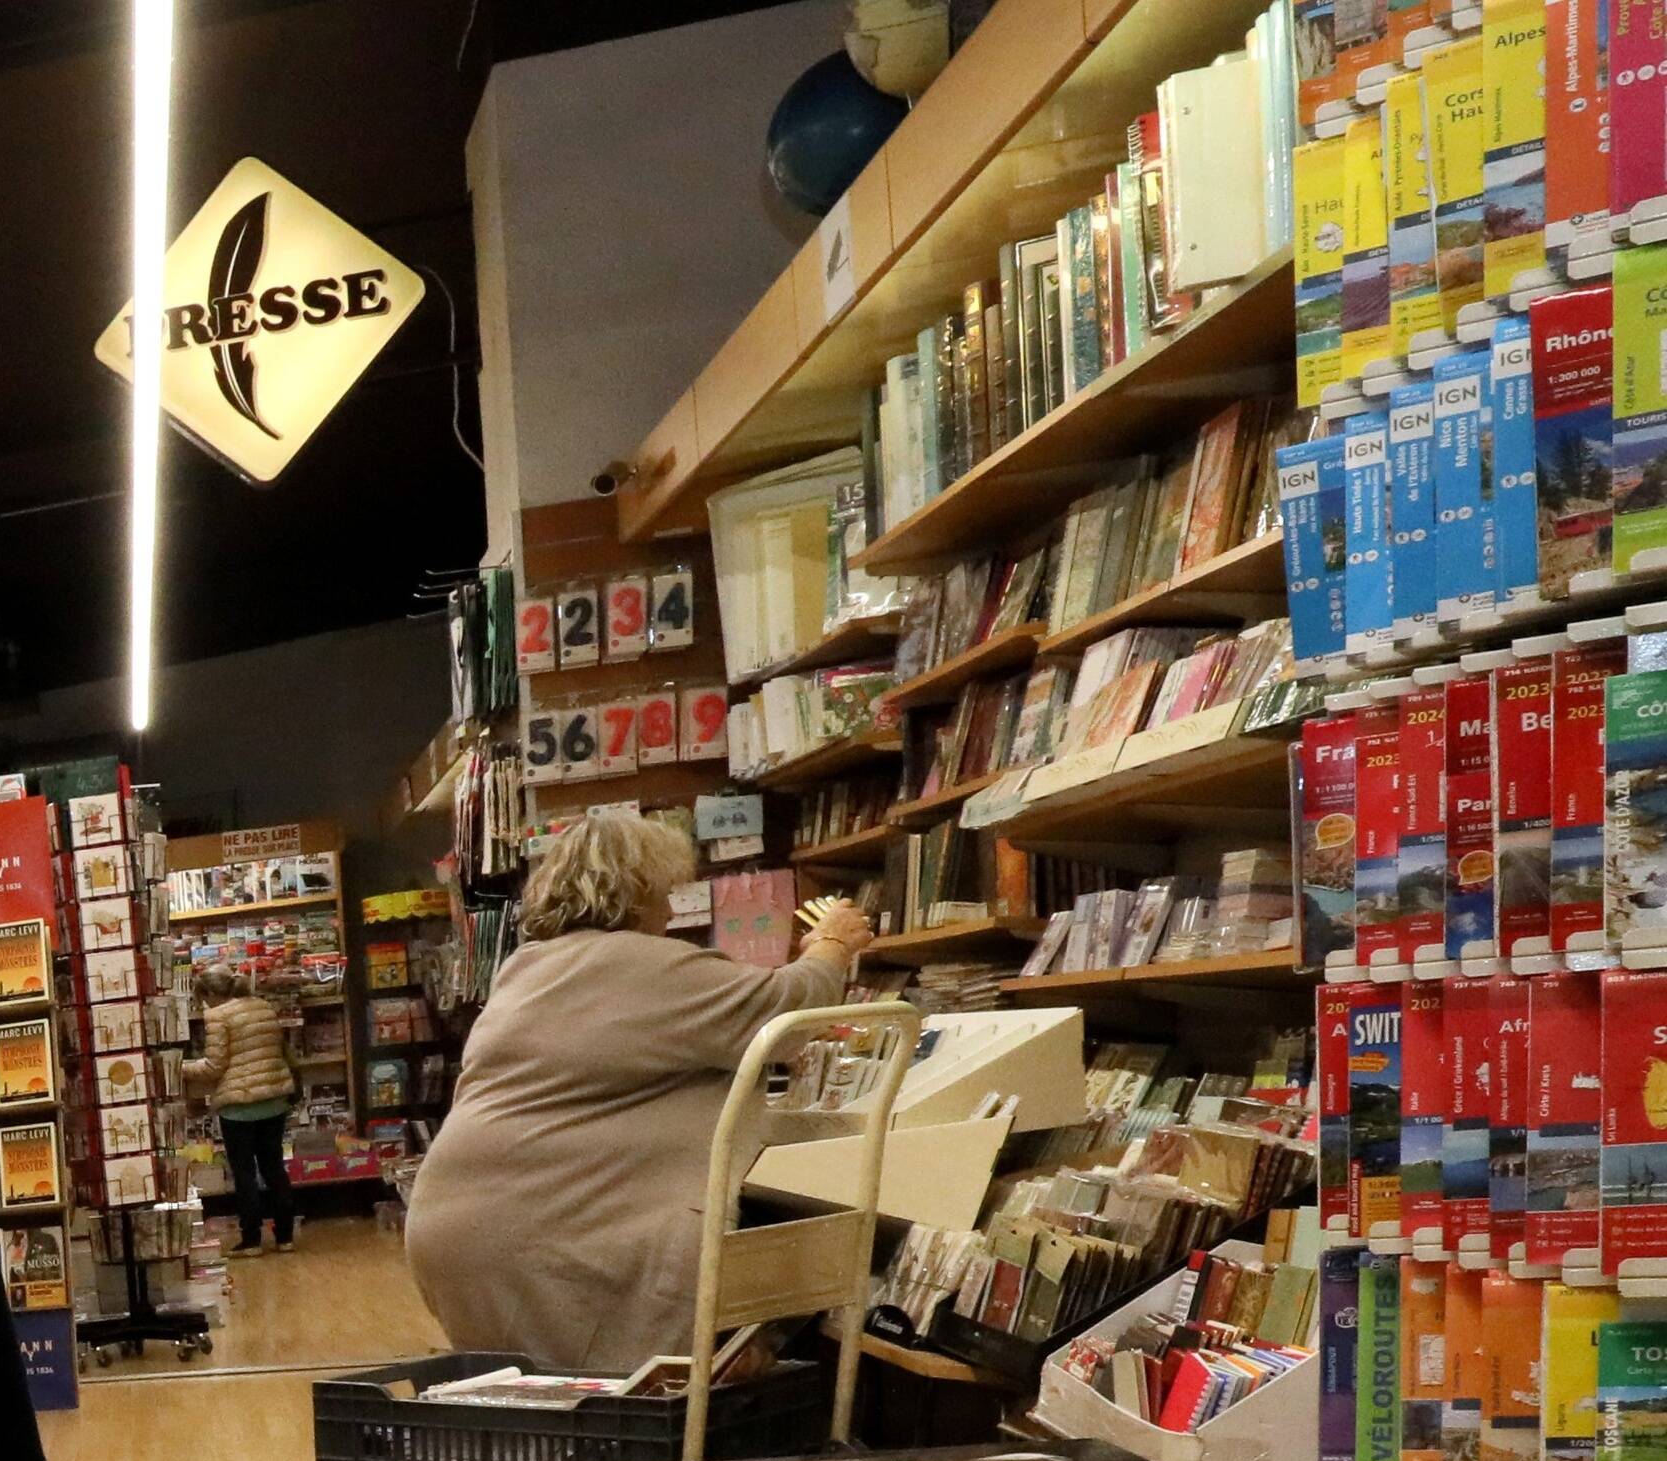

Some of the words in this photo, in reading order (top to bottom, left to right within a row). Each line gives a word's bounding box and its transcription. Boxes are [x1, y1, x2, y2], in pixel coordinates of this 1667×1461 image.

[124, 268, 392, 357] RESSE
[1439, 385, 1477, 406] IGN
[1393, 412, 1430, 432] IGN
[1348, 439, 1383, 458] IGN
[1282, 471, 1315, 489] IGN
[610, 586, 645, 637] 3
[657, 581, 690, 633] 4
[520, 604, 552, 655] 2
[563, 598, 594, 647] 2
[1507, 682, 1551, 700] 2023
[603, 707, 636, 757] 7
[641, 699, 675, 748] 8
[692, 692, 727, 744] 9
[1521, 711, 1551, 732] Be
[526, 717, 557, 766] 5
[561, 713, 597, 762] 6
[223, 833, 241, 847] NE
[244, 830, 269, 845] PAS
[271, 826, 300, 842] LIRE
[18, 924, 40, 937] LEVY
[22, 1025, 44, 1036] LEVY
[1354, 1011, 1402, 1047] SWIT
[3, 1130, 27, 1142] MARC
[28, 1128, 50, 1139] LEVY
[27, 1257, 60, 1270] MUSSO
